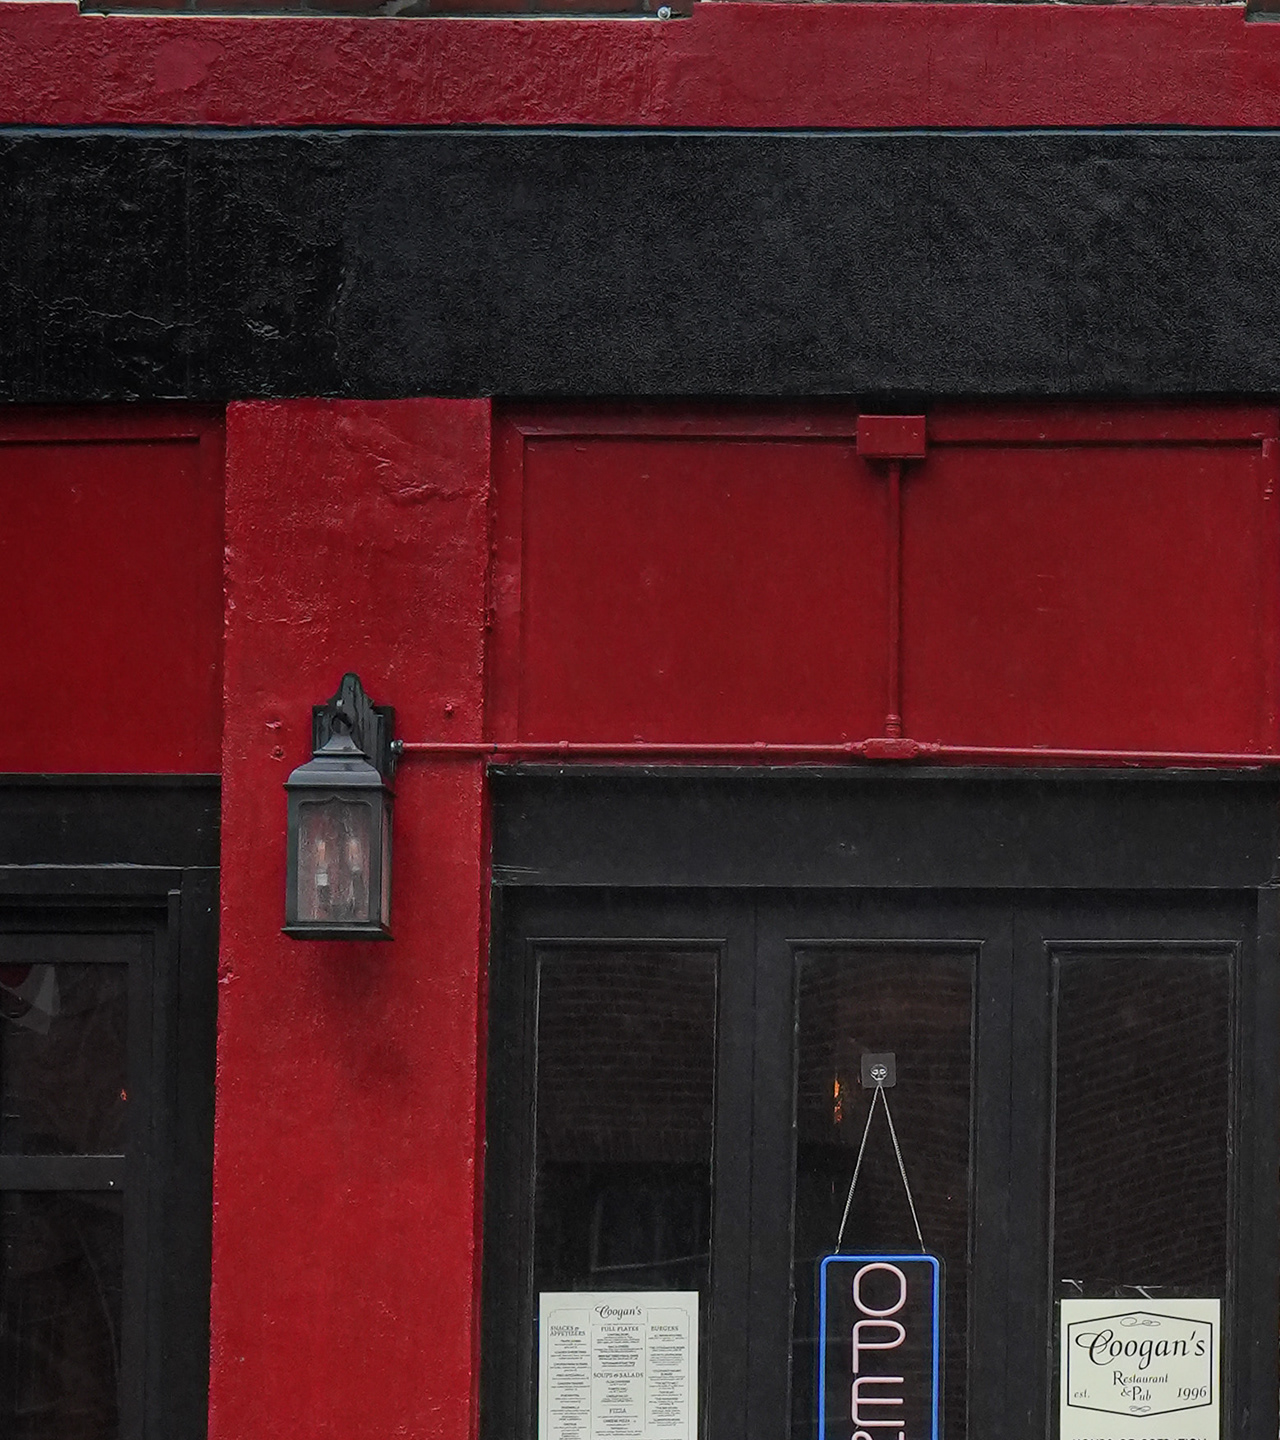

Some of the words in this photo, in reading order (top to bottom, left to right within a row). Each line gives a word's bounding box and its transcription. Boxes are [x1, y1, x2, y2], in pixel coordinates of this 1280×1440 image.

[594, 1305, 642, 1320] Coogan's
[1075, 1329, 1205, 1370] Coogan's
[1112, 1370, 1168, 1386] Restaurant
[1074, 1389, 1090, 1398] est.
[1177, 1386, 1207, 1400] 1996
